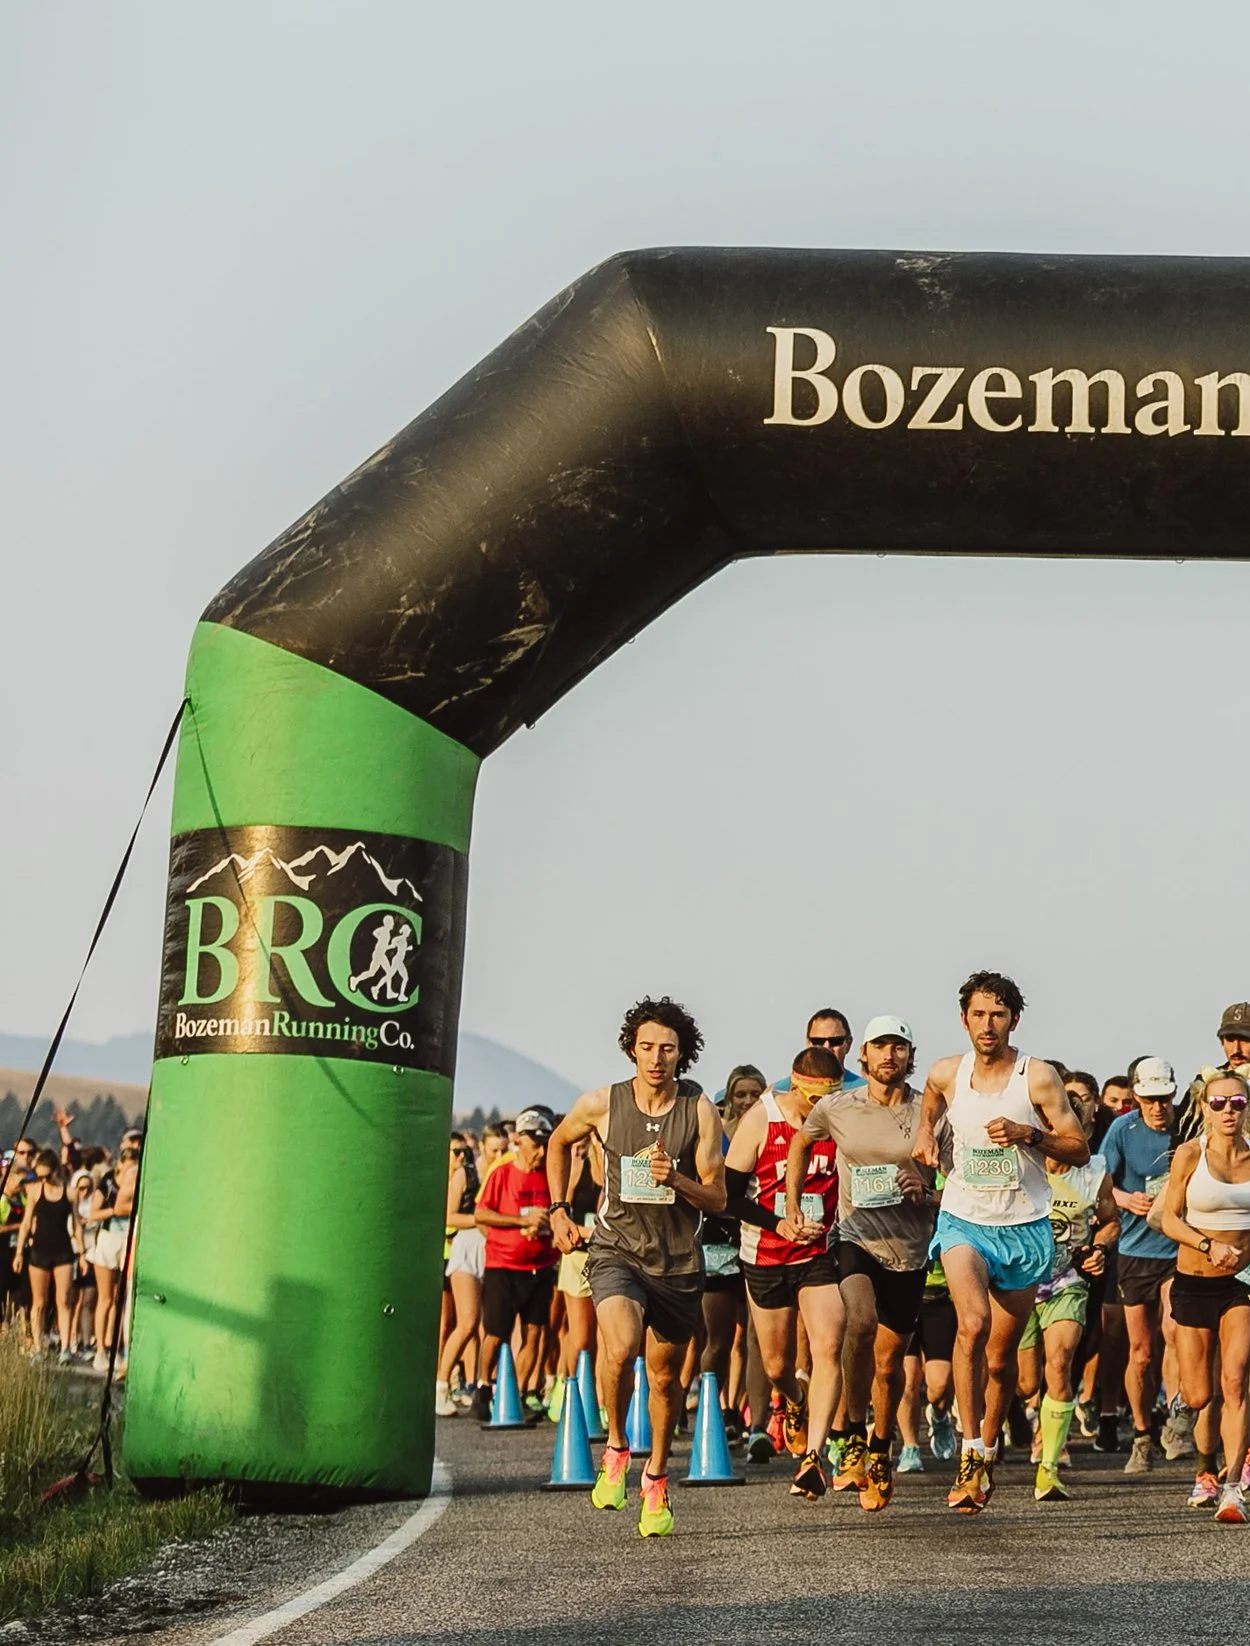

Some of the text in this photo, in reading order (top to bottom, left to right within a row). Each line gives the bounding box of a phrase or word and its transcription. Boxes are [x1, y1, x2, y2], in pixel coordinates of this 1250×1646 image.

[177, 894, 423, 1013] BRC
[968, 1158, 1013, 1176] 1230
[854, 1176, 894, 1193] 1161
